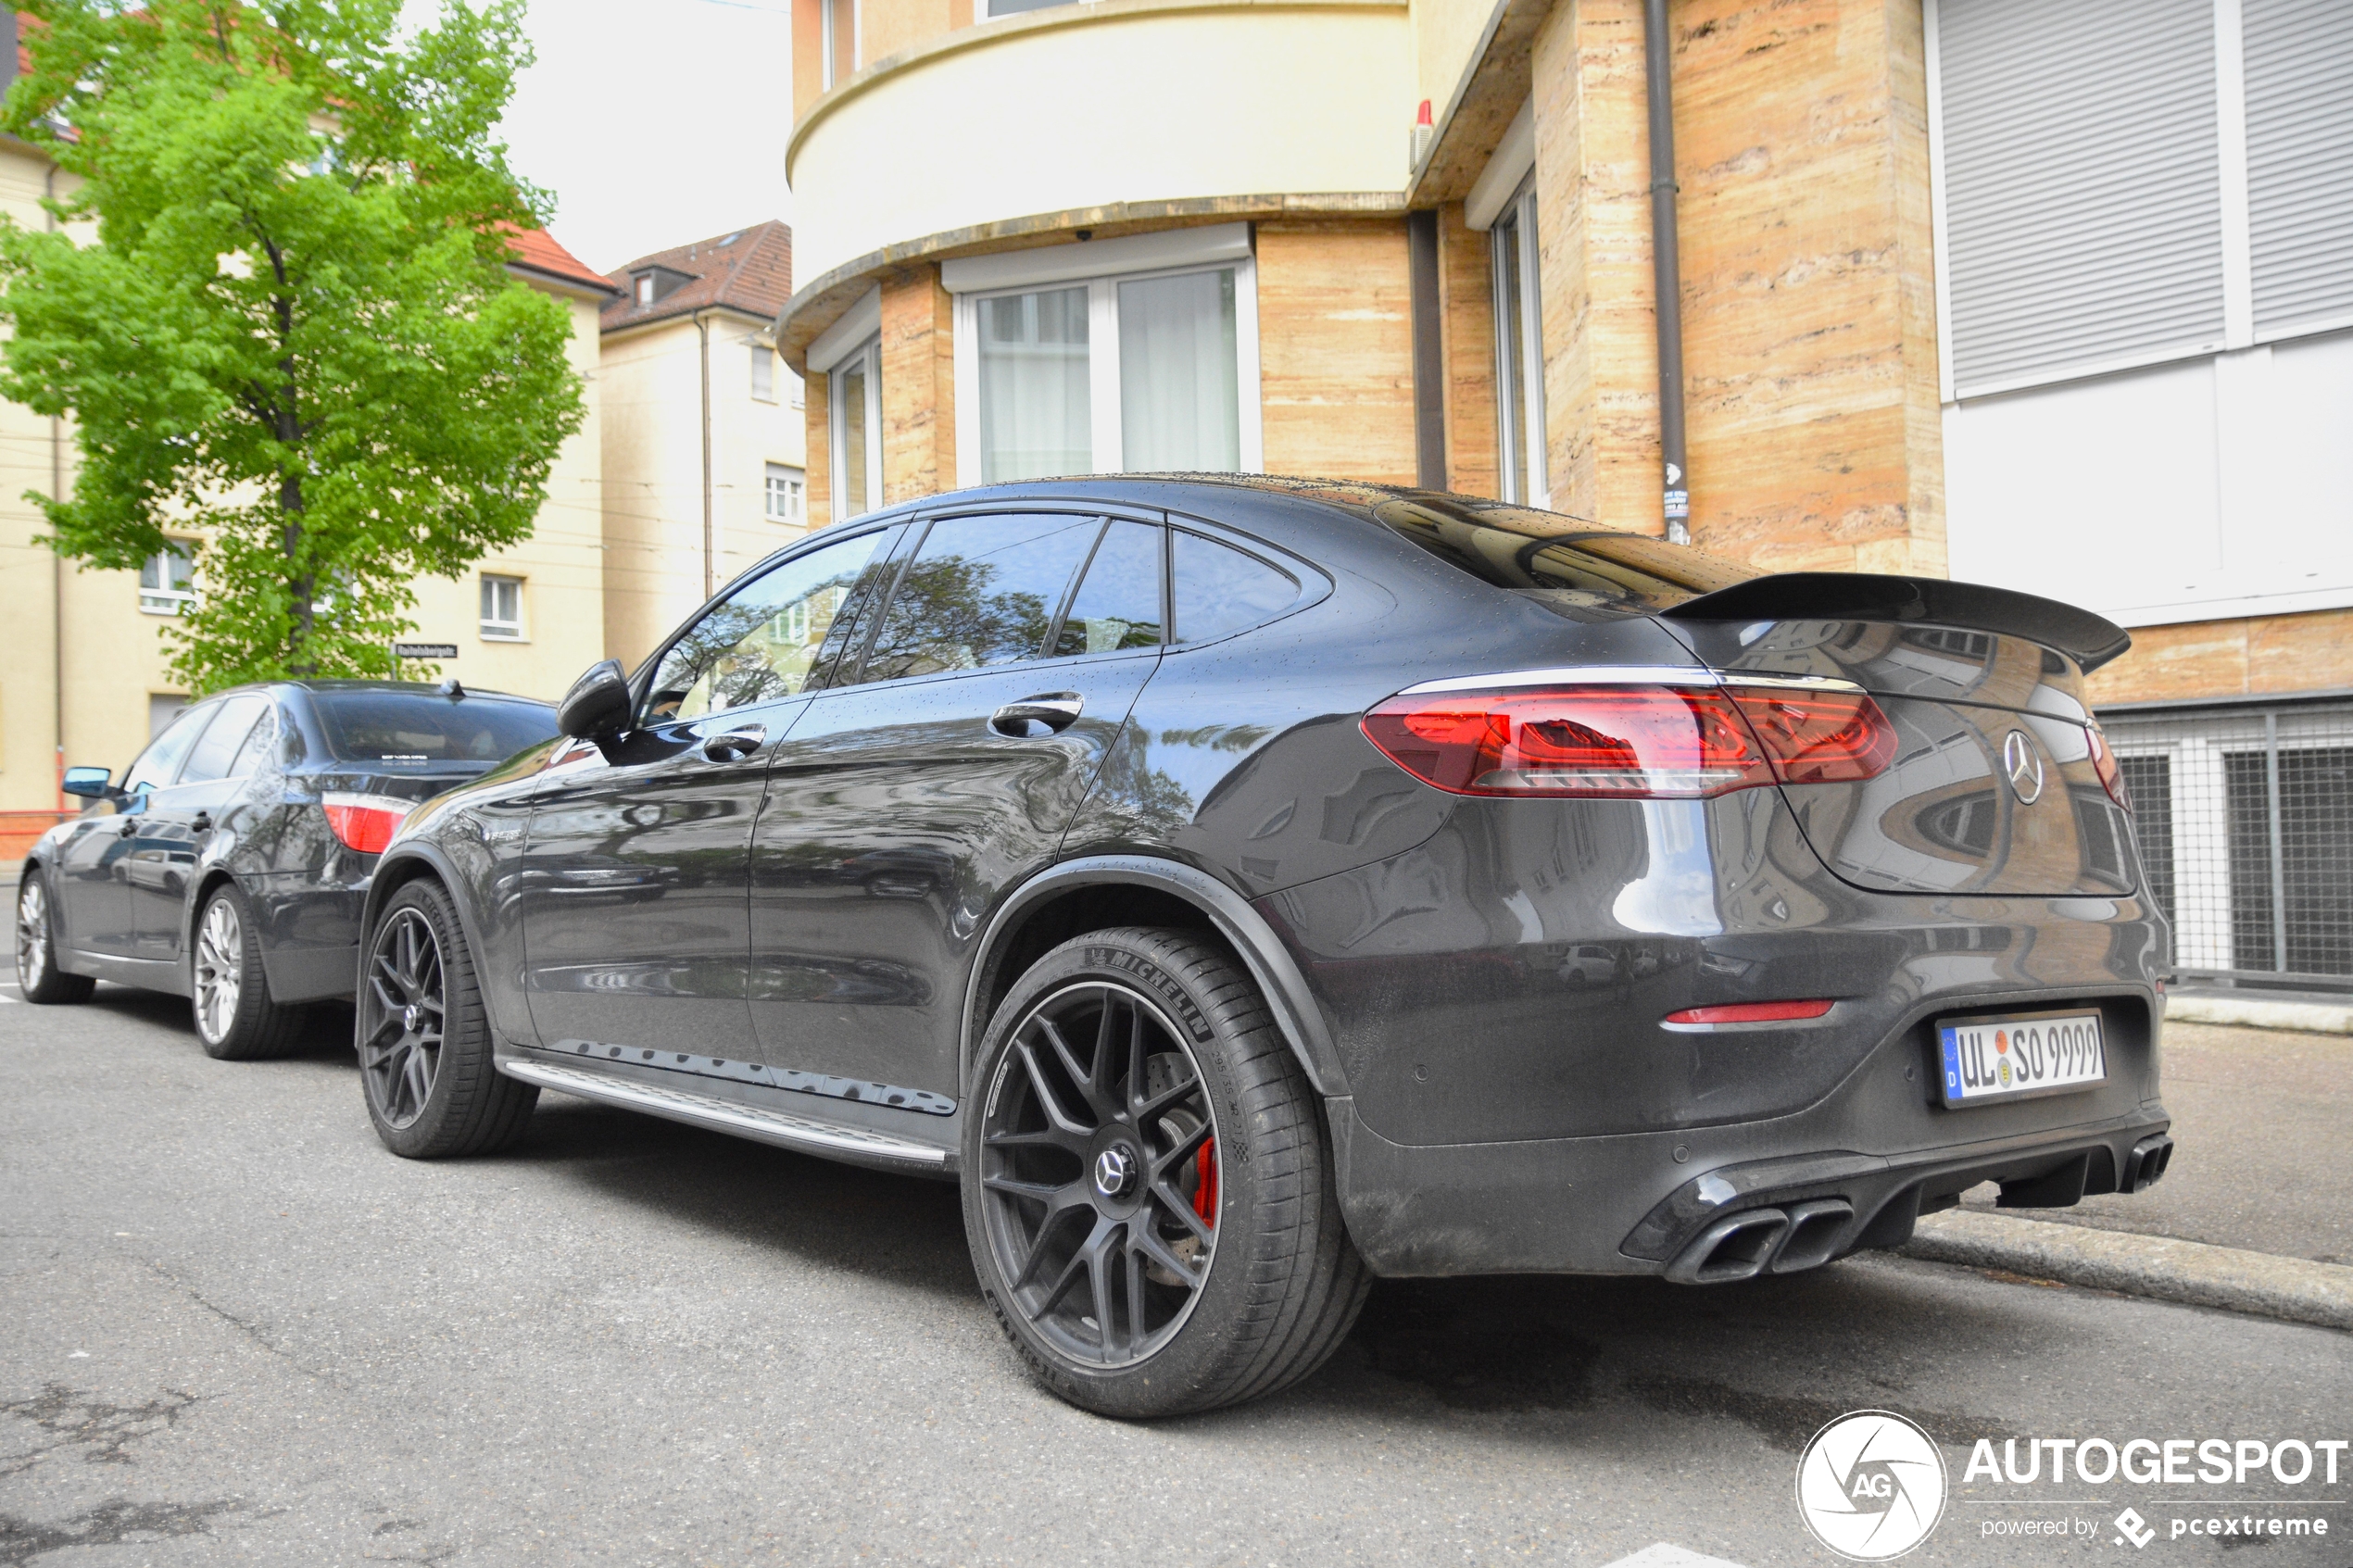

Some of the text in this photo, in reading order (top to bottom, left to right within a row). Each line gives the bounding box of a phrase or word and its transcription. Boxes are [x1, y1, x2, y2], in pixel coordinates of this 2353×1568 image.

[1111, 951, 1209, 1035] MICHELIN
[1948, 1072, 1957, 1087] D
[1959, 1023, 2098, 1088] UL SO 9999
